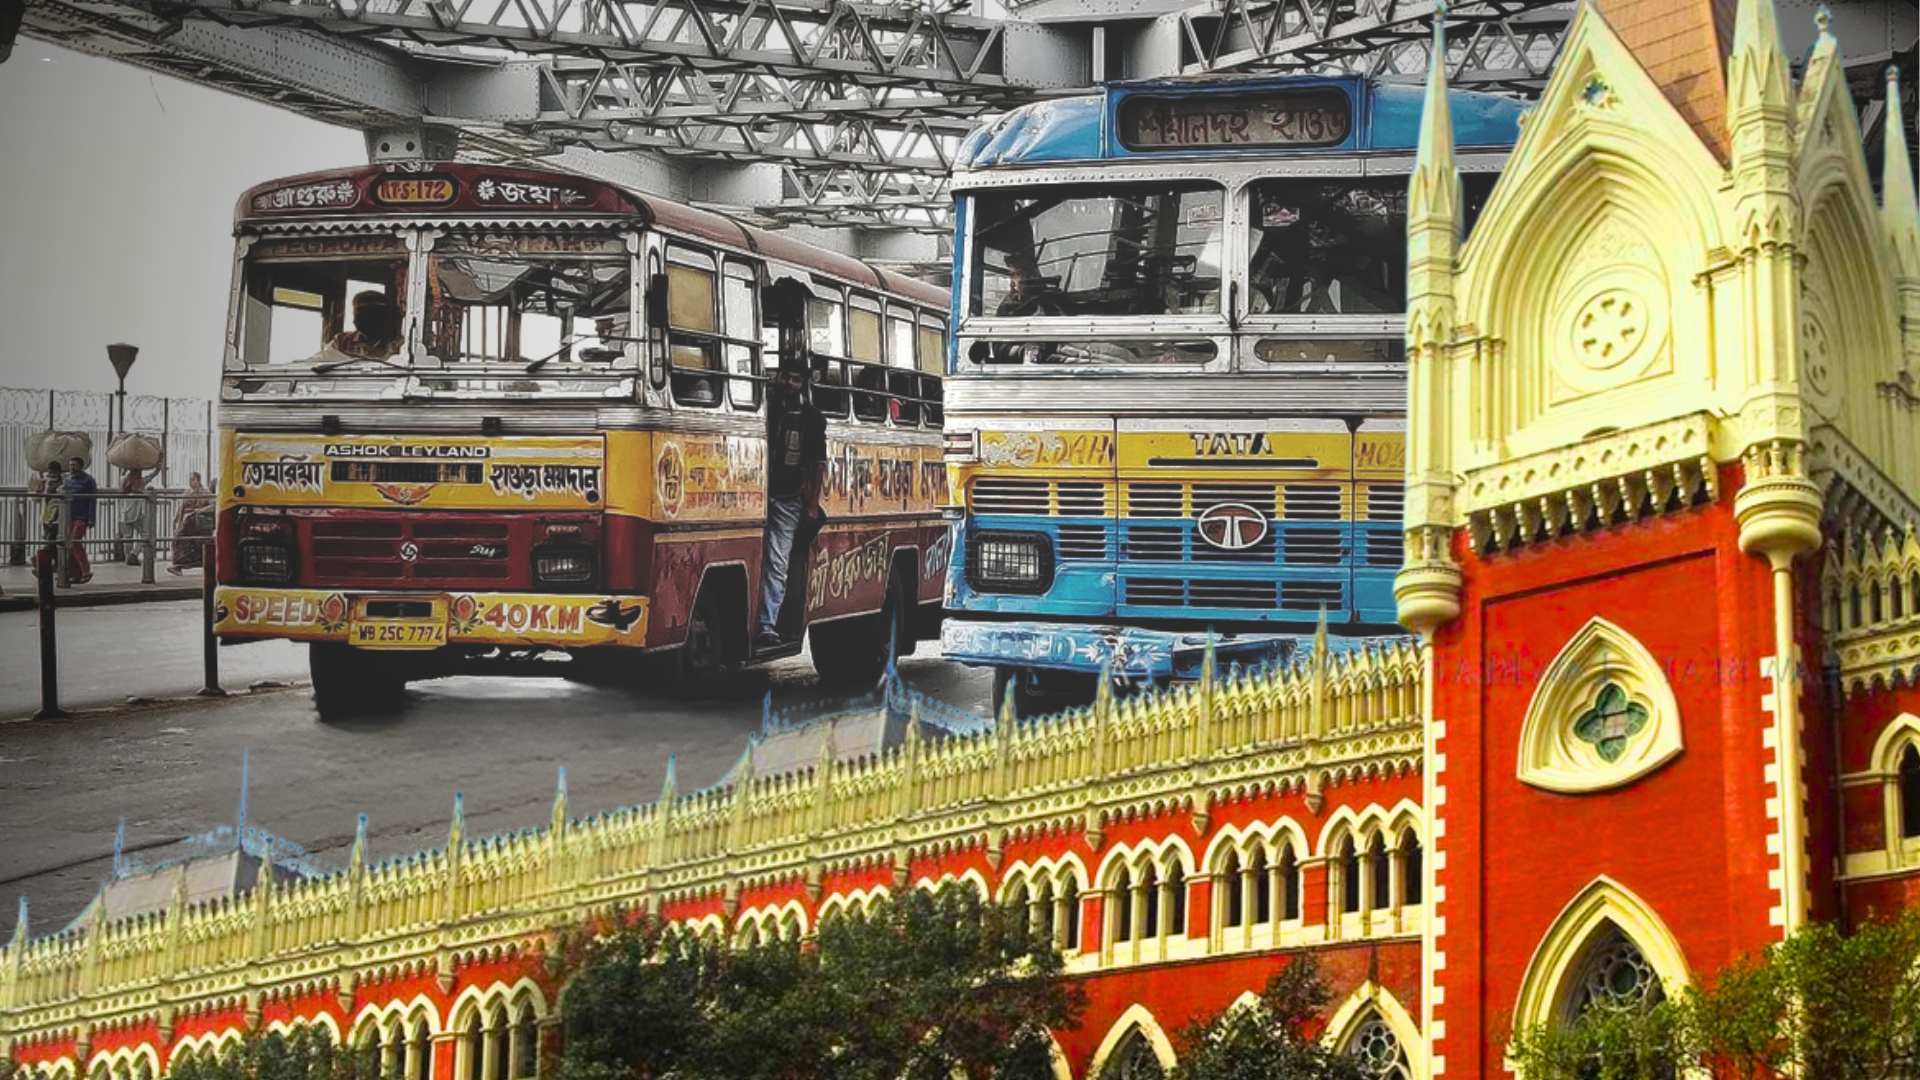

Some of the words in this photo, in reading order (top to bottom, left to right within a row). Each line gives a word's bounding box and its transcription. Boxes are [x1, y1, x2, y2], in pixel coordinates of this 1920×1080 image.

[326, 445, 391, 458] ASHOK
[401, 445, 486, 458] LEYLAND
[1191, 432, 1274, 455] TATA
[235, 594, 316, 624] SPEED
[359, 625, 376, 641] WB
[379, 625, 405, 641] 25C
[408, 625, 444, 642] 7774
